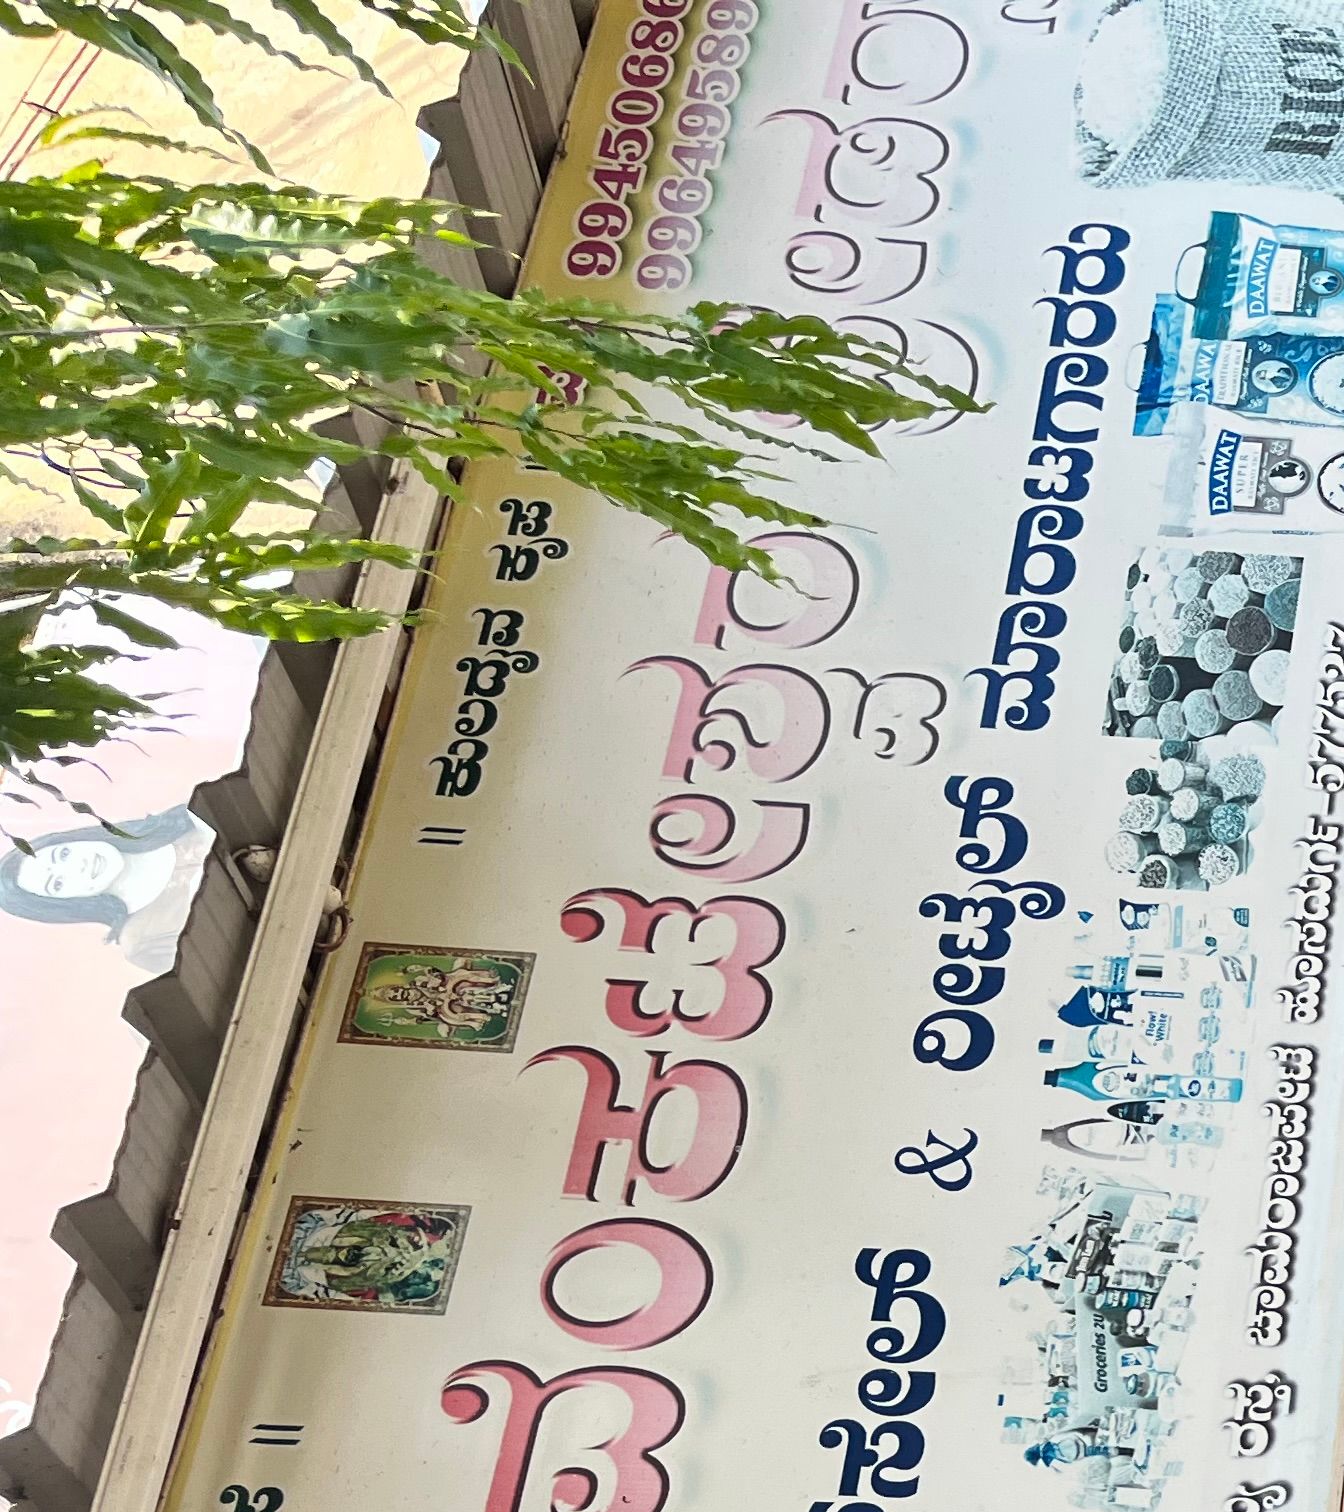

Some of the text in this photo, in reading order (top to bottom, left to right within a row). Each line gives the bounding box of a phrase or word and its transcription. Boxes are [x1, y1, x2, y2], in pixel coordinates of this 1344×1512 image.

[1264, 27, 1344, 158] RICE
[1252, 240, 1278, 314] DAAWAT
[1194, 342, 1217, 403] DAAWA
[963, 222, 1130, 732] ಮಾರಾಟಗಾರರು
[1212, 432, 1238, 511] DAAWAT
[428, 608, 539, 797] ಕುಲದೈವ
[488, 499, 569, 582] ಕೃಪೆ
[905, 777, 1065, 1069] ರೀಟೈಲ್
[895, 1129, 977, 1190] &
[1243, 1044, 1315, 1346] ಚಾಮರಾಜಪೇಟೆ
[1092, 1333, 1109, 1393] Groceries
